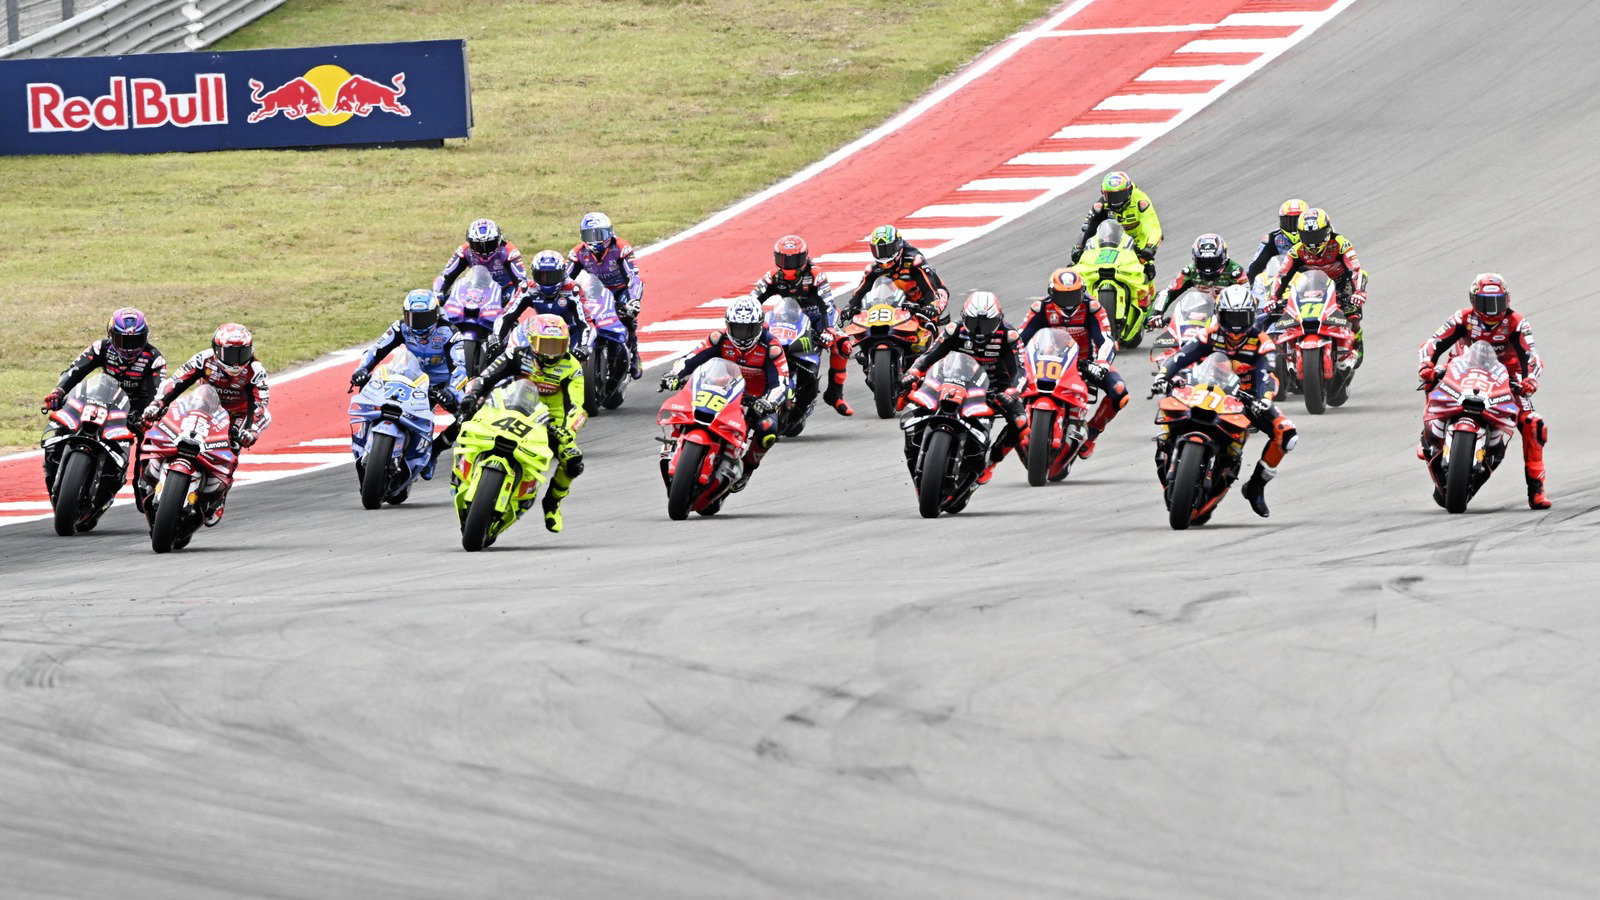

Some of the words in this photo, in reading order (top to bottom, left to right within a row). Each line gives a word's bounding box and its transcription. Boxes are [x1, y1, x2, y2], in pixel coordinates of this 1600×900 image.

[27, 77, 128, 132] Red
[130, 73, 228, 128] Bull
[1095, 249, 1119, 264] 21
[868, 308, 892, 323] 33
[1035, 360, 1063, 380] 10
[383, 381, 413, 401] 73
[1189, 389, 1221, 409] 37
[1440, 382, 1461, 399] Lenovo
[1489, 395, 1512, 404] Lenovo
[692, 391, 728, 412] 36
[158, 422, 177, 439] Lenovo
[491, 416, 533, 438] 49
[205, 441, 228, 450] Lenovo
